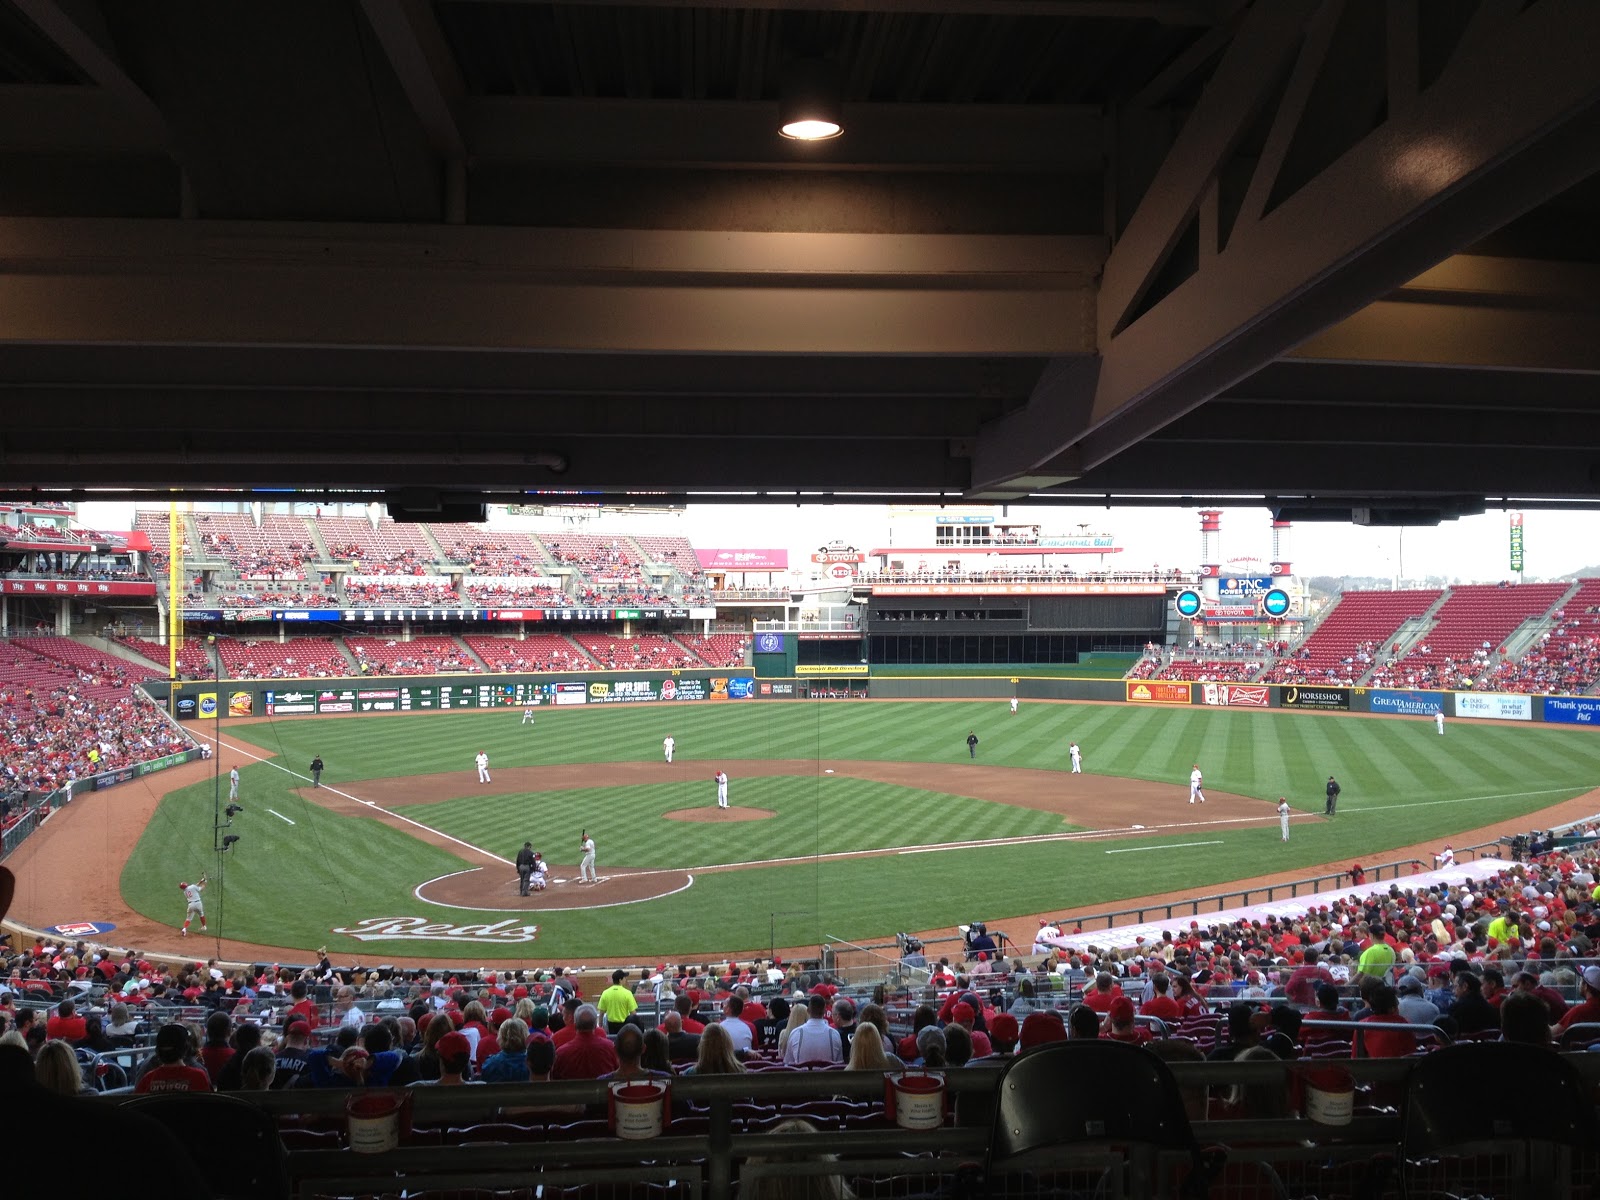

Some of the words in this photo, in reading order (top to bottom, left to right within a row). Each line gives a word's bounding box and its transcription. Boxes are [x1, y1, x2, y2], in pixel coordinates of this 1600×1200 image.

[1238, 579, 1263, 589] PNC
[614, 682, 633, 692] SUPER
[634, 681, 650, 691] SUITE
[231, 693, 252, 705] Kahn's
[1232, 689, 1265, 699] Budweiser
[1300, 692, 1343, 701] HORSESHOE
[1373, 696, 1401, 706] GREAT
[1398, 700, 1440, 710] AMERICAN
[1577, 702, 1595, 711] you,
[1577, 713, 1591, 721] P&G
[332, 917, 538, 943] Reds
[763, 1026, 777, 1036] VOT
[274, 1057, 307, 1072] EWART
